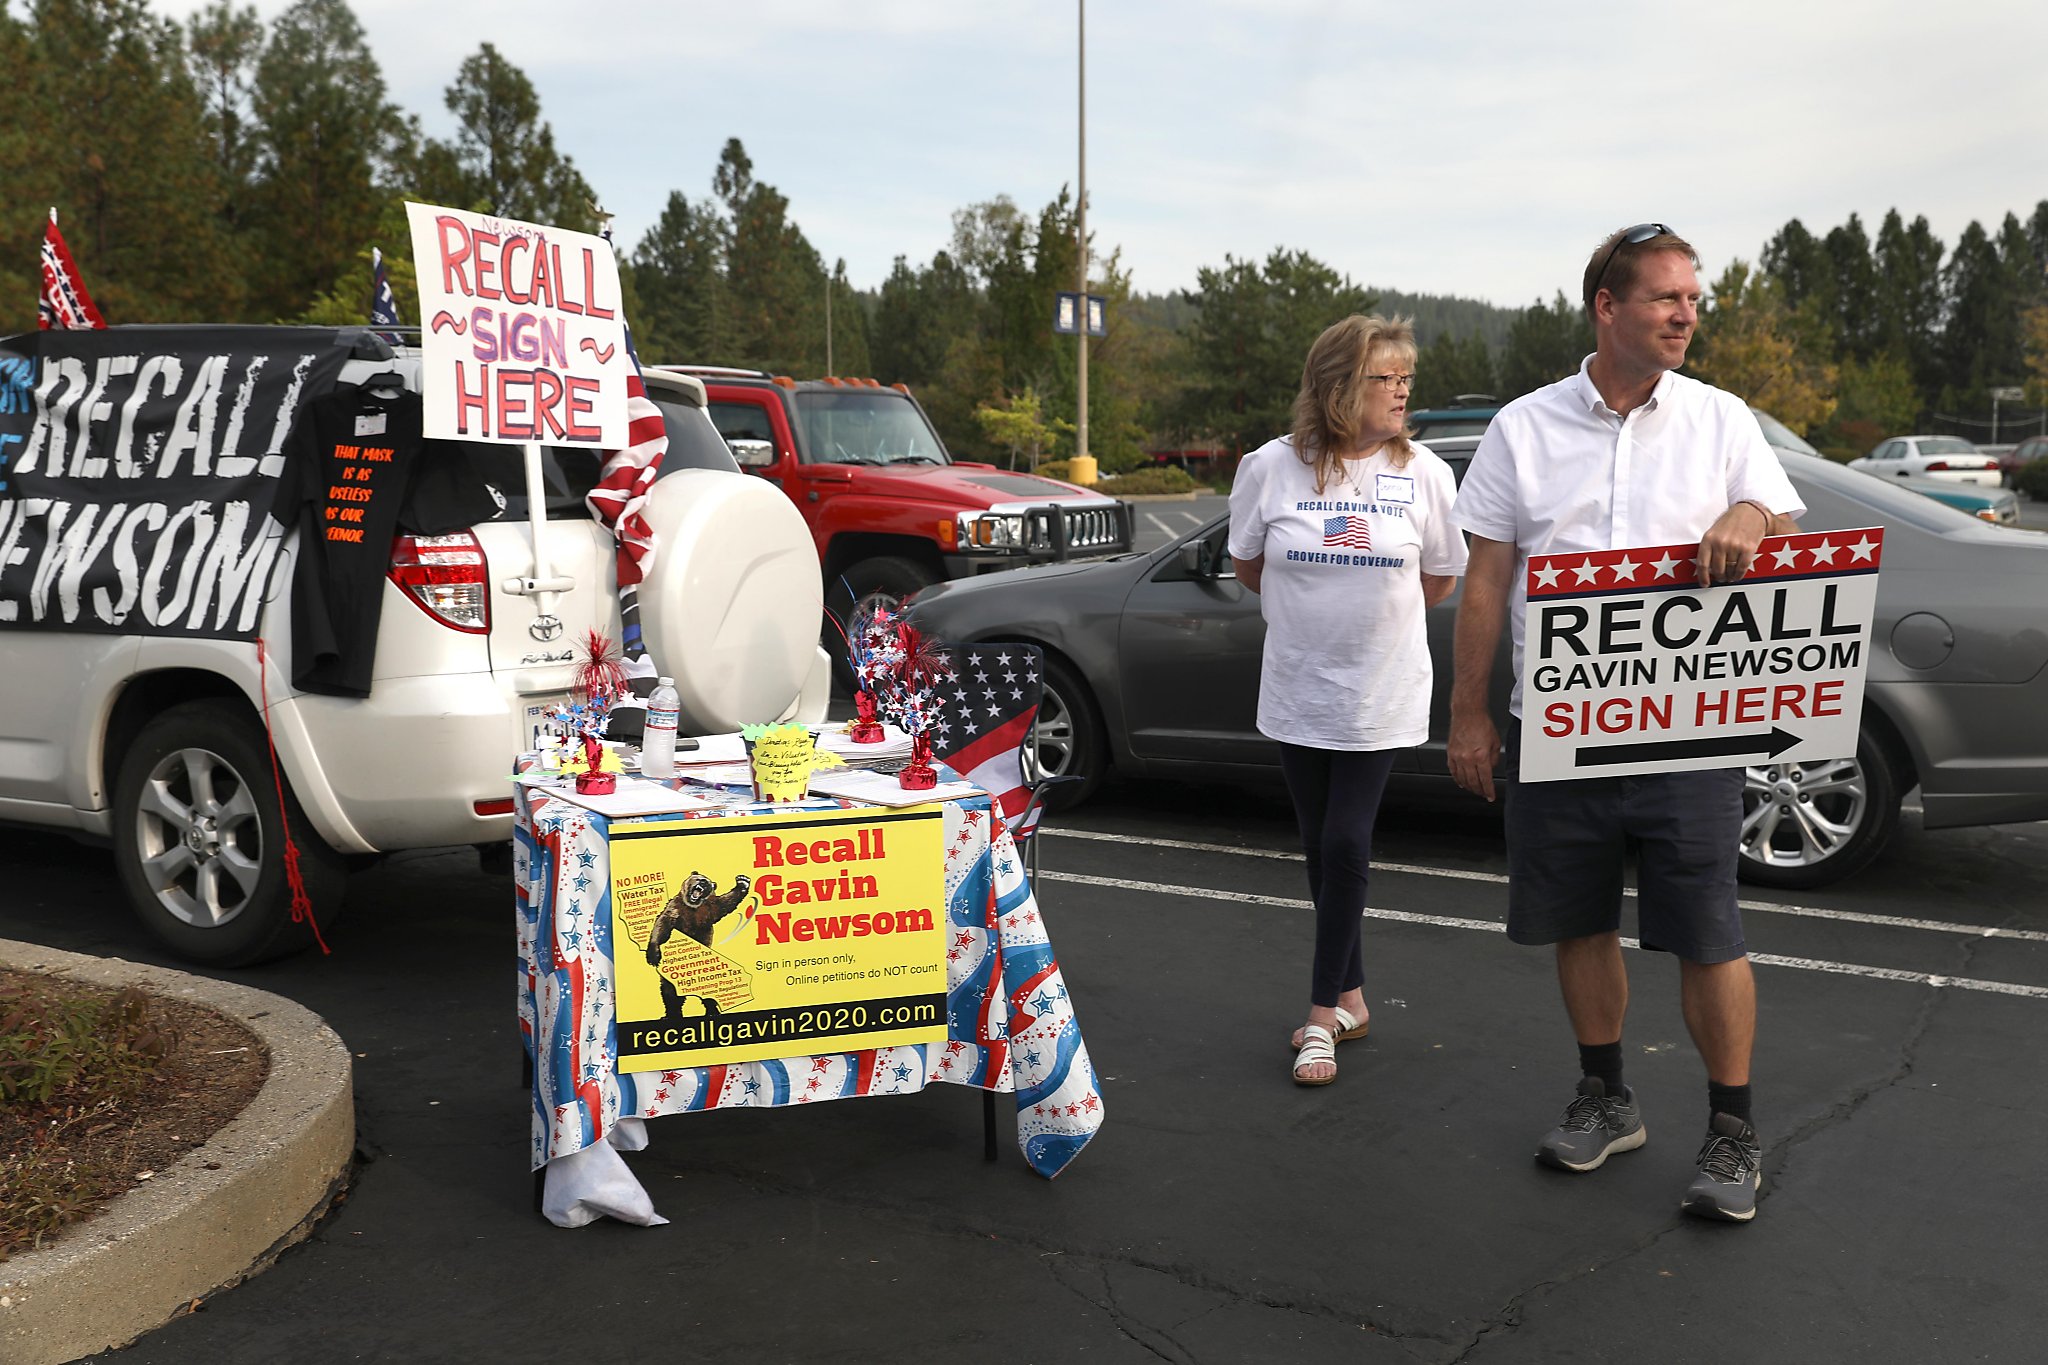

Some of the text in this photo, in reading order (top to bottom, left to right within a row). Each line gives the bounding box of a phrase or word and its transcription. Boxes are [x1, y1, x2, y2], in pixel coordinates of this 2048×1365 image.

[481, 217, 548, 243] Newsom
[435, 215, 615, 320] RECALL
[471, 306, 569, 368] SIGN
[456, 360, 602, 442] HERE
[13, 354, 316, 478] RECALL
[334, 444, 394, 462] THAT MASK
[342, 466, 373, 481] IS AS
[329, 485, 373, 502] USELESS
[340, 508, 364, 522] OUR
[1297, 501, 1403, 518] RECALL GAVIN & VOTE
[327, 526, 364, 543] ERNOR
[0, 498, 287, 632] EWSOM
[1287, 550, 1404, 568] GROVER FOR GOVERNOR
[1539, 584, 1862, 660] RECALL
[1533, 640, 1861, 693] GAVIN NEWSOM
[528, 706, 540, 716] FEB
[1542, 680, 1845, 738] SIGN HERE
[752, 828, 886, 869] Recall
[616, 872, 664, 888] NO MORE!
[754, 869, 879, 907] Gavin
[621, 887, 664, 900] Water Tax
[624, 895, 662, 908] FREE Illegal
[624, 903, 660, 914] Immigrant
[755, 906, 934, 945] Newsom
[662, 955, 687, 965] Highest
[701, 949, 712, 957] Tax
[678, 945, 702, 955] Control
[661, 956, 720, 973] Government
[670, 962, 729, 980] Overreach
[755, 953, 856, 972] Sign in person only,
[677, 968, 742, 987] High Income Tax
[786, 963, 938, 986] Online petitions do NOT count
[681, 982, 718, 994] Threatening
[719, 979, 733, 987] Prop
[719, 983, 748, 992] Regulations
[633, 1003, 936, 1048] recallgavin2020.com
